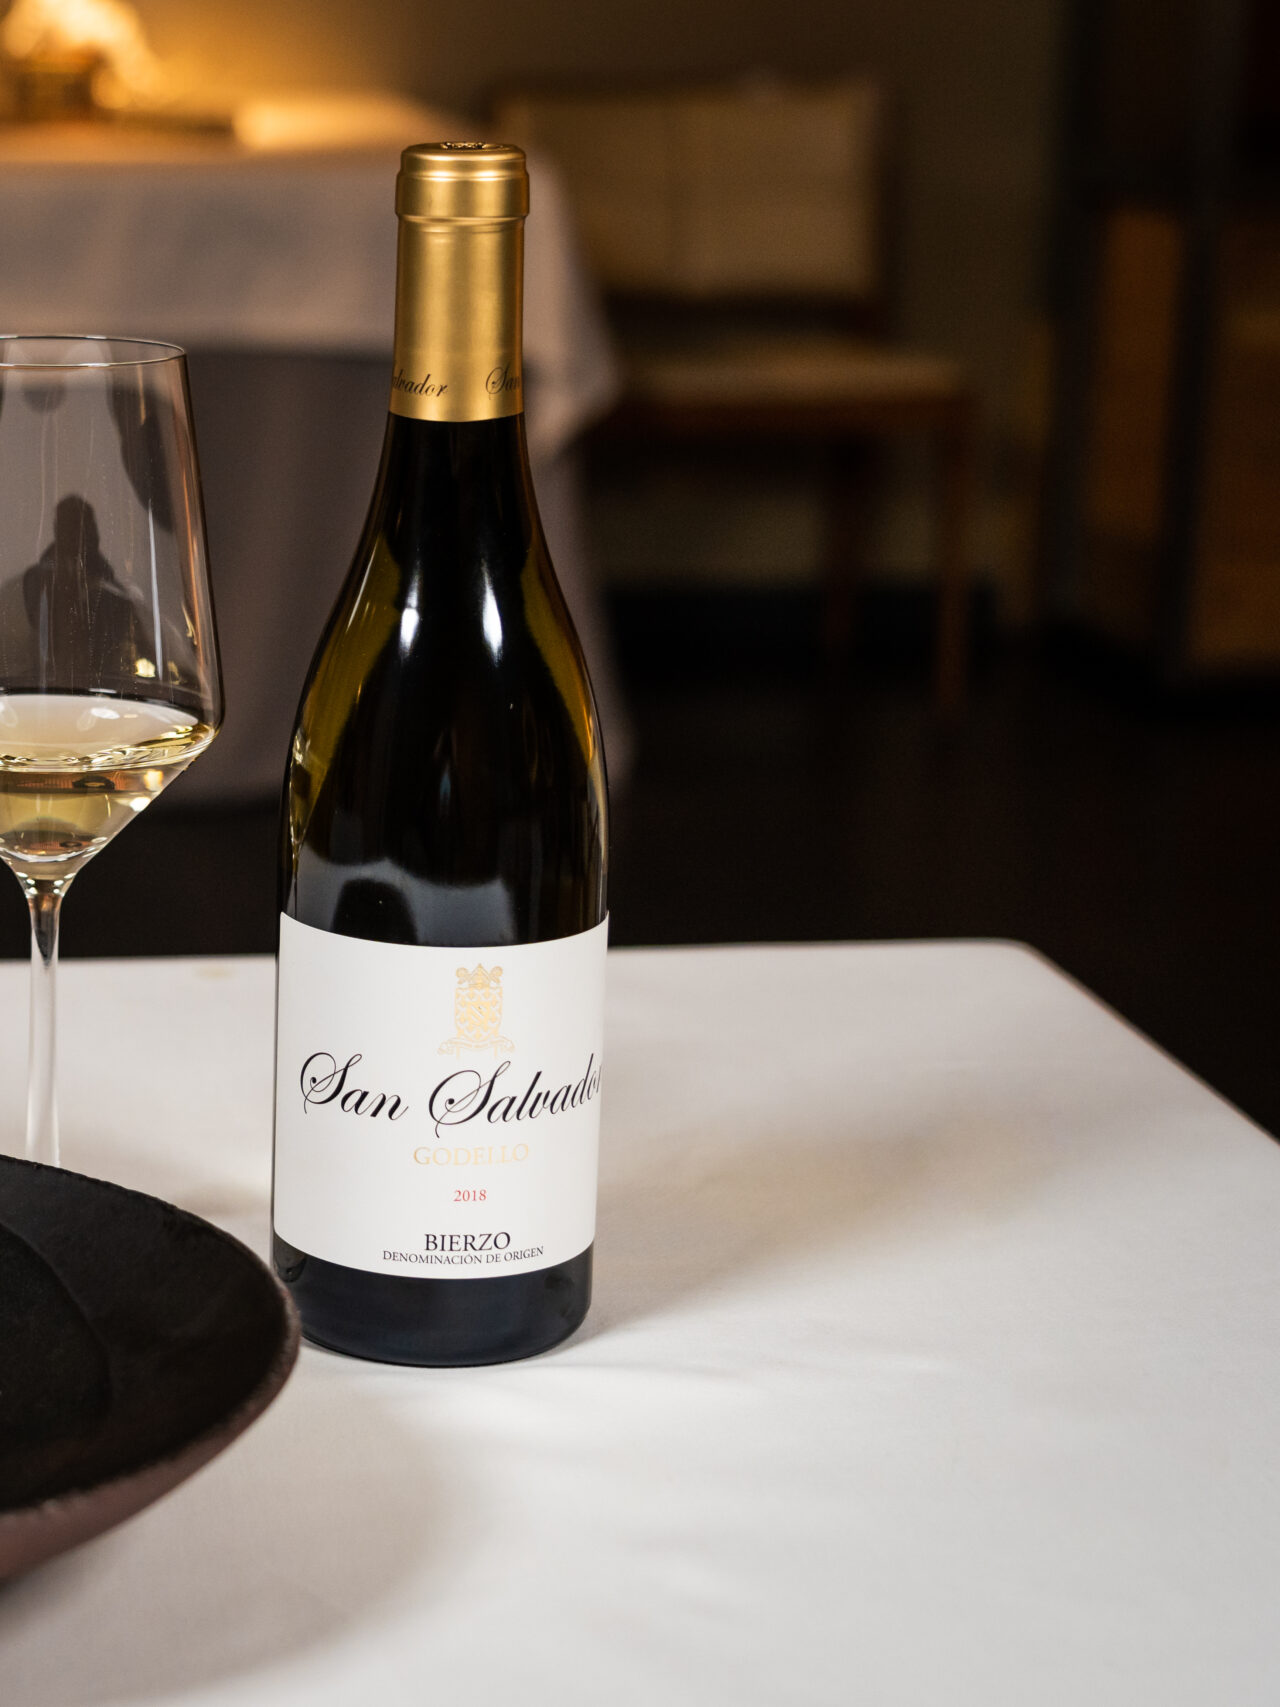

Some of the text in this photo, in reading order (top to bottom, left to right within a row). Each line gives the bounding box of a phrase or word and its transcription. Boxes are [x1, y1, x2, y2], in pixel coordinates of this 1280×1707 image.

[300, 1051, 409, 1121] San
[413, 1143, 530, 1166] GODELLO
[453, 1189, 487, 1203] 2018
[424, 1232, 510, 1252] BIERZO
[383, 1246, 543, 1265] DENOMINACIÓN DE ORIGEN
